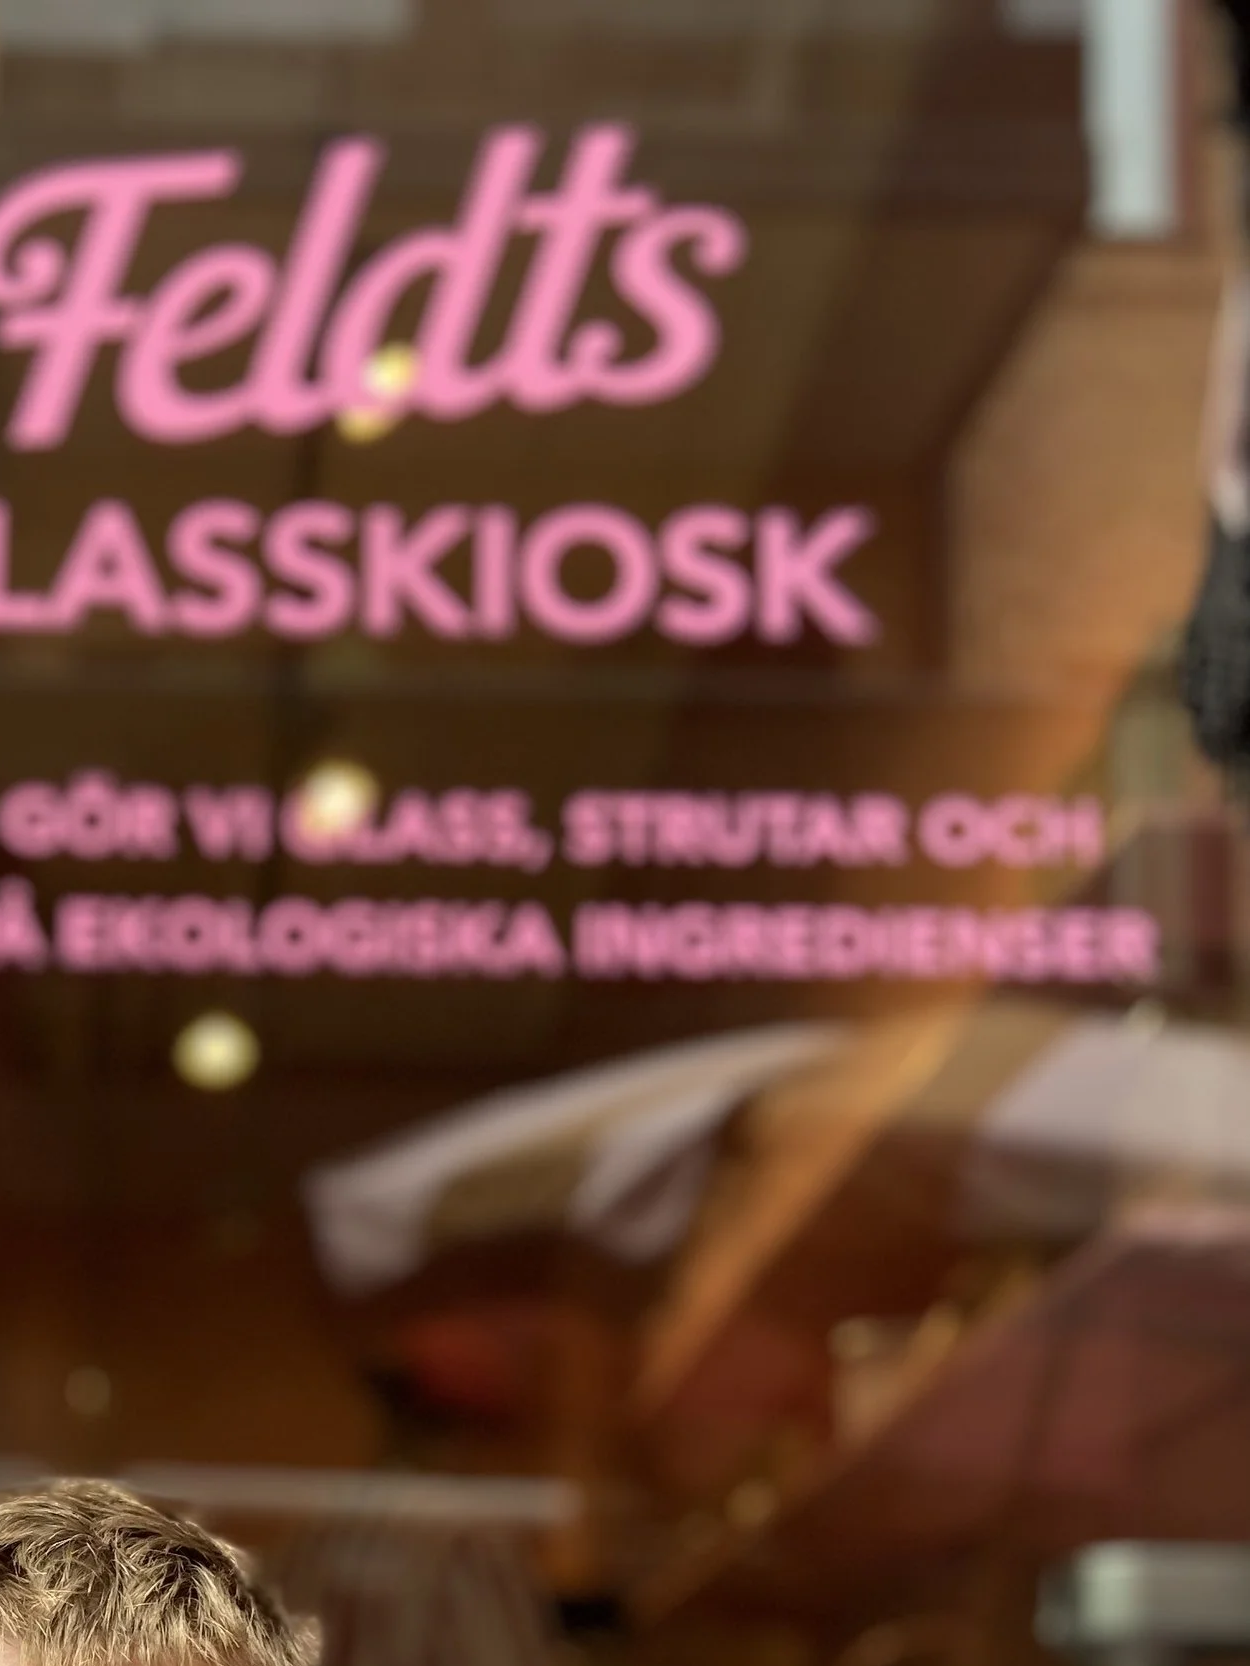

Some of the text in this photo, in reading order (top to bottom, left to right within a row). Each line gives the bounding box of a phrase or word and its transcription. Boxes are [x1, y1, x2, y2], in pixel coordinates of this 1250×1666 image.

[0, 771, 176, 858] GÖR
[188, 786, 269, 858] VI
[564, 791, 905, 865] STRUTAR
[921, 794, 1101, 865] OCH
[58, 896, 561, 975] EKOLOGISKA
[576, 905, 1159, 978] INGREDIENSER
